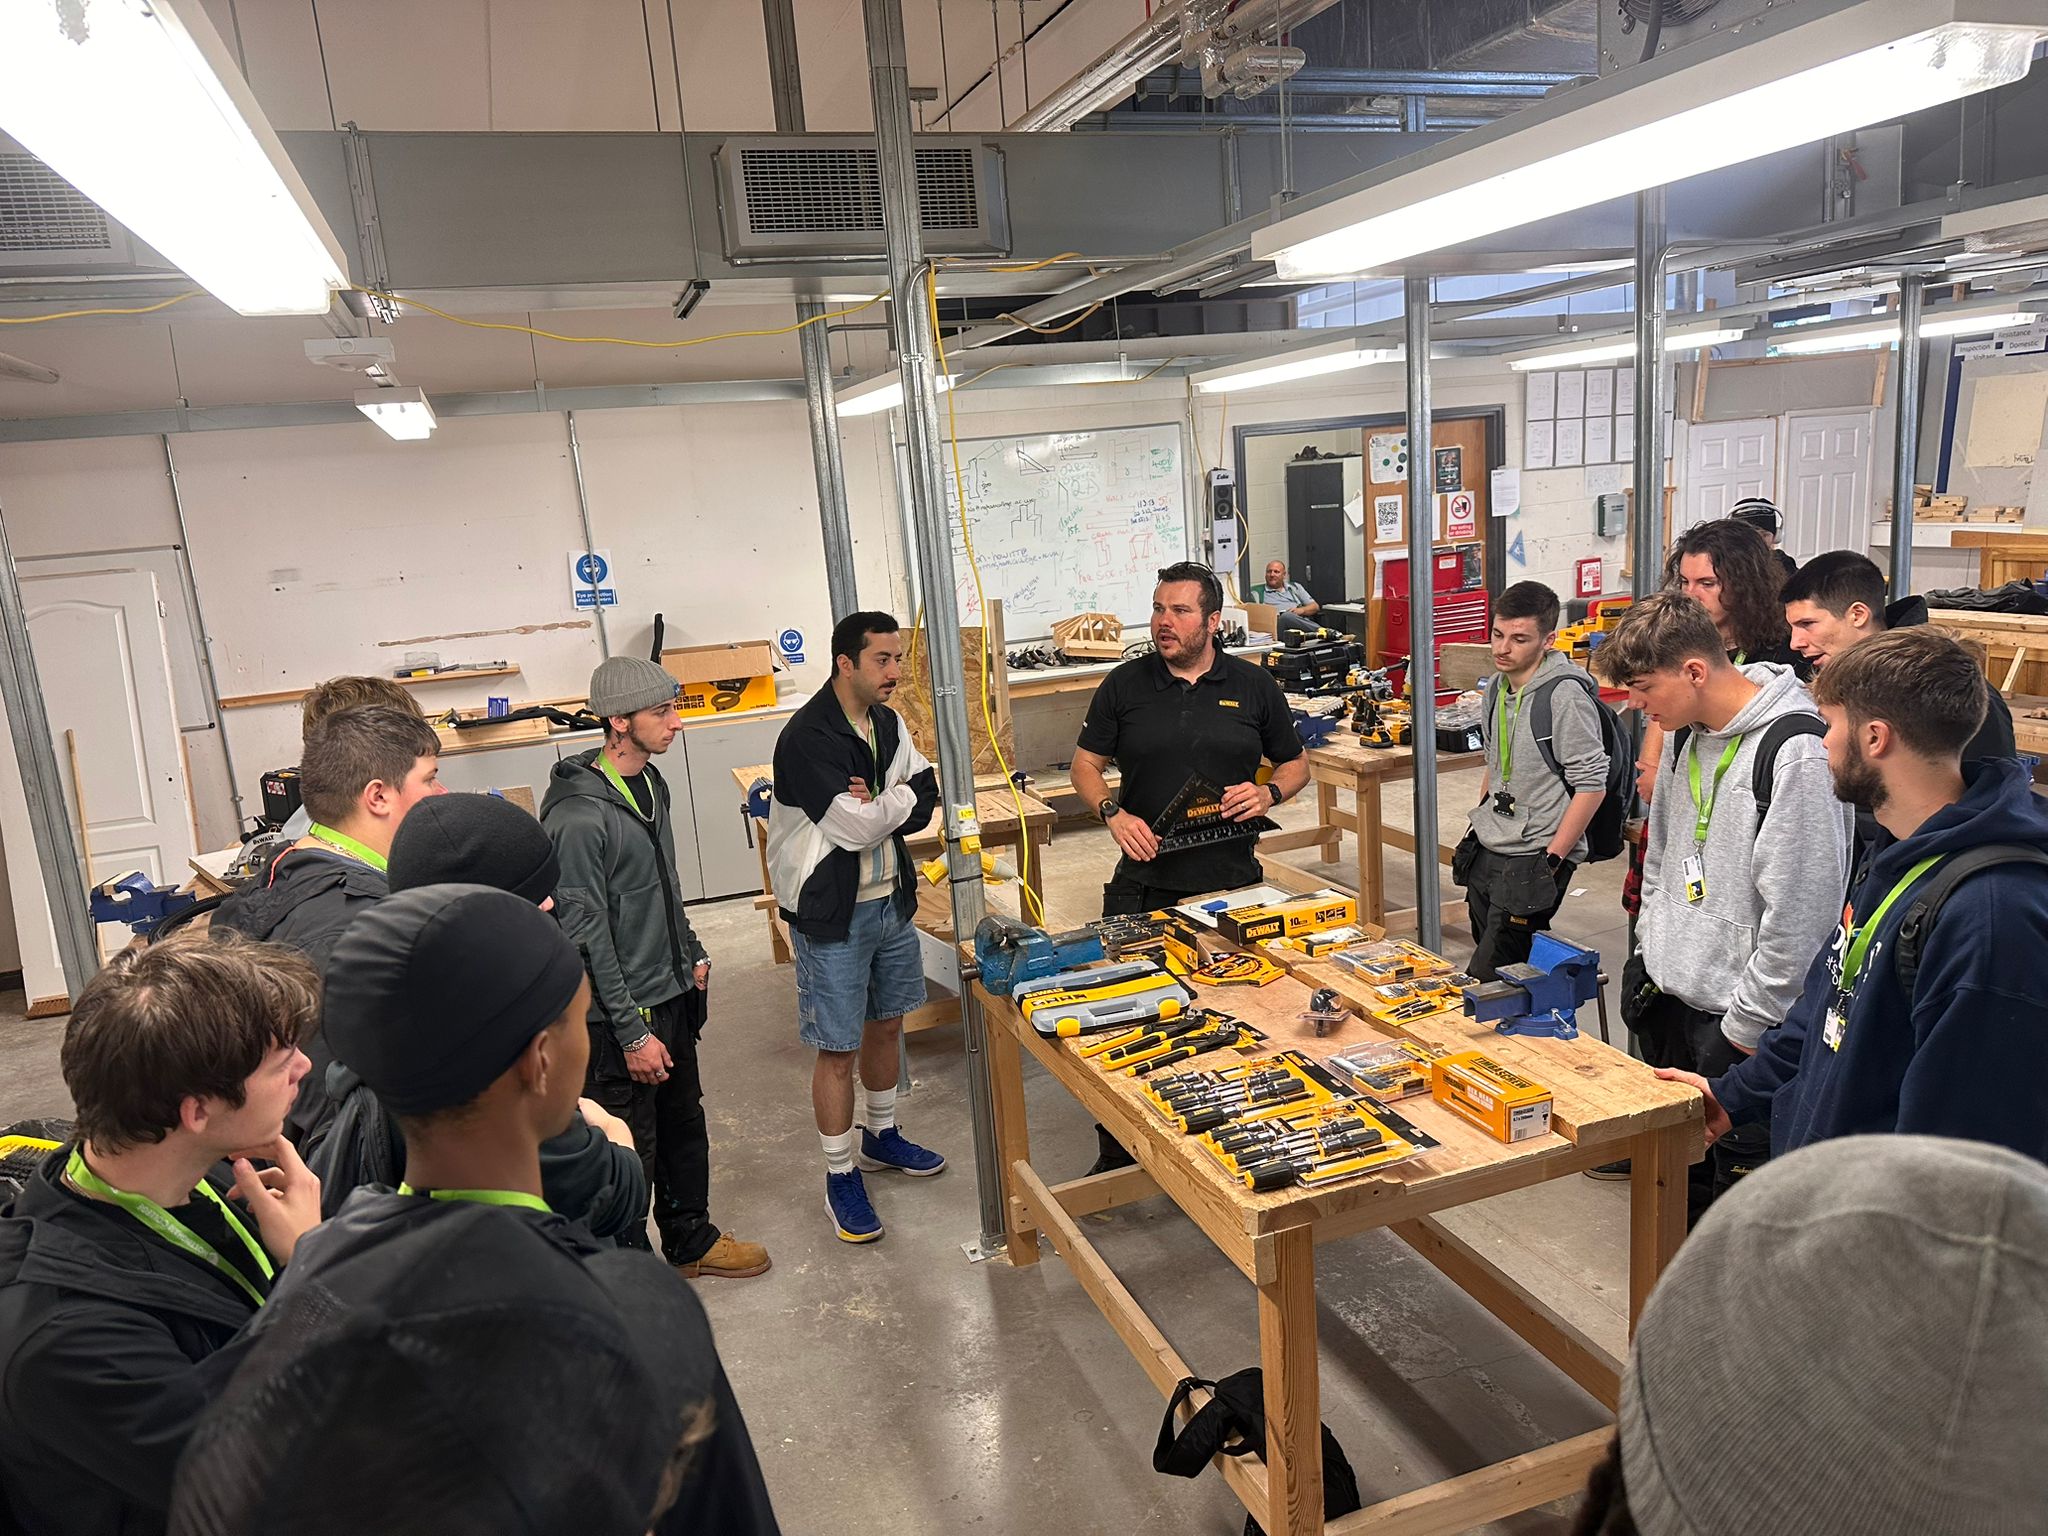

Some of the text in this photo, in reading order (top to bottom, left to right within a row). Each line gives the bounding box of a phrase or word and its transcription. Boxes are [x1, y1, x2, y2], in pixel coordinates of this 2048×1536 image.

[1998, 329, 2032, 339] Resistance
[1960, 344, 1991, 353] Inspection
[2009, 340, 2040, 349] Domestic
[1246, 921, 1280, 939] DEWALT
